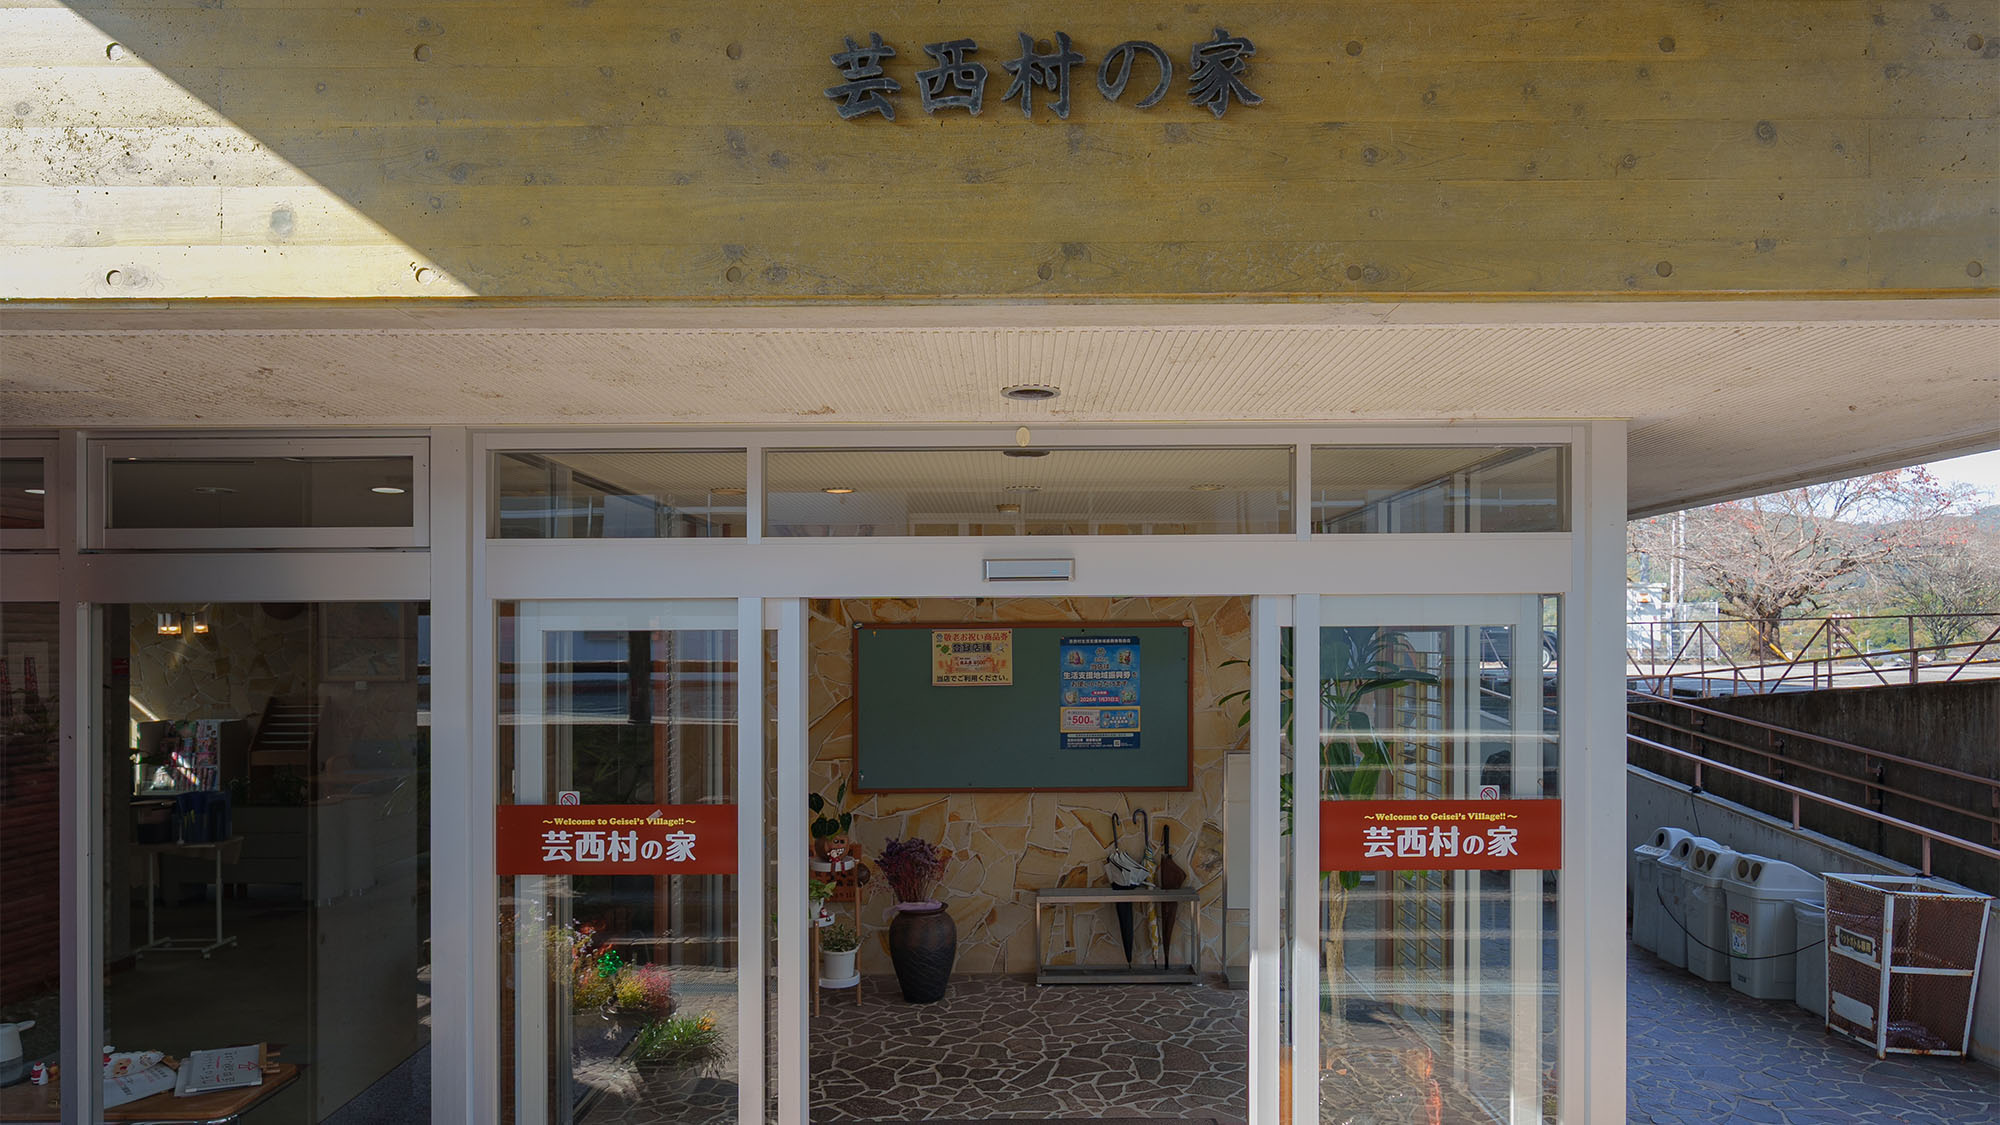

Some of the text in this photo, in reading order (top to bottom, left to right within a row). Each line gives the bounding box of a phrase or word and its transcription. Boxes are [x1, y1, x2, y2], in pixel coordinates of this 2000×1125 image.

[824, 28, 1265, 120] 芸西村の家
[944, 633, 1008, 641] 敬老お祝い商品券
[952, 643, 992, 653] 登録店舗
[598, 818, 608, 826] to
[609, 817, 644, 826] Geisei's
[1419, 813, 1429, 821] to
[1431, 813, 1466, 821] Geisei's
[541, 830, 697, 862] 芸西村の家
[1363, 825, 1518, 858] 芸西村の家
